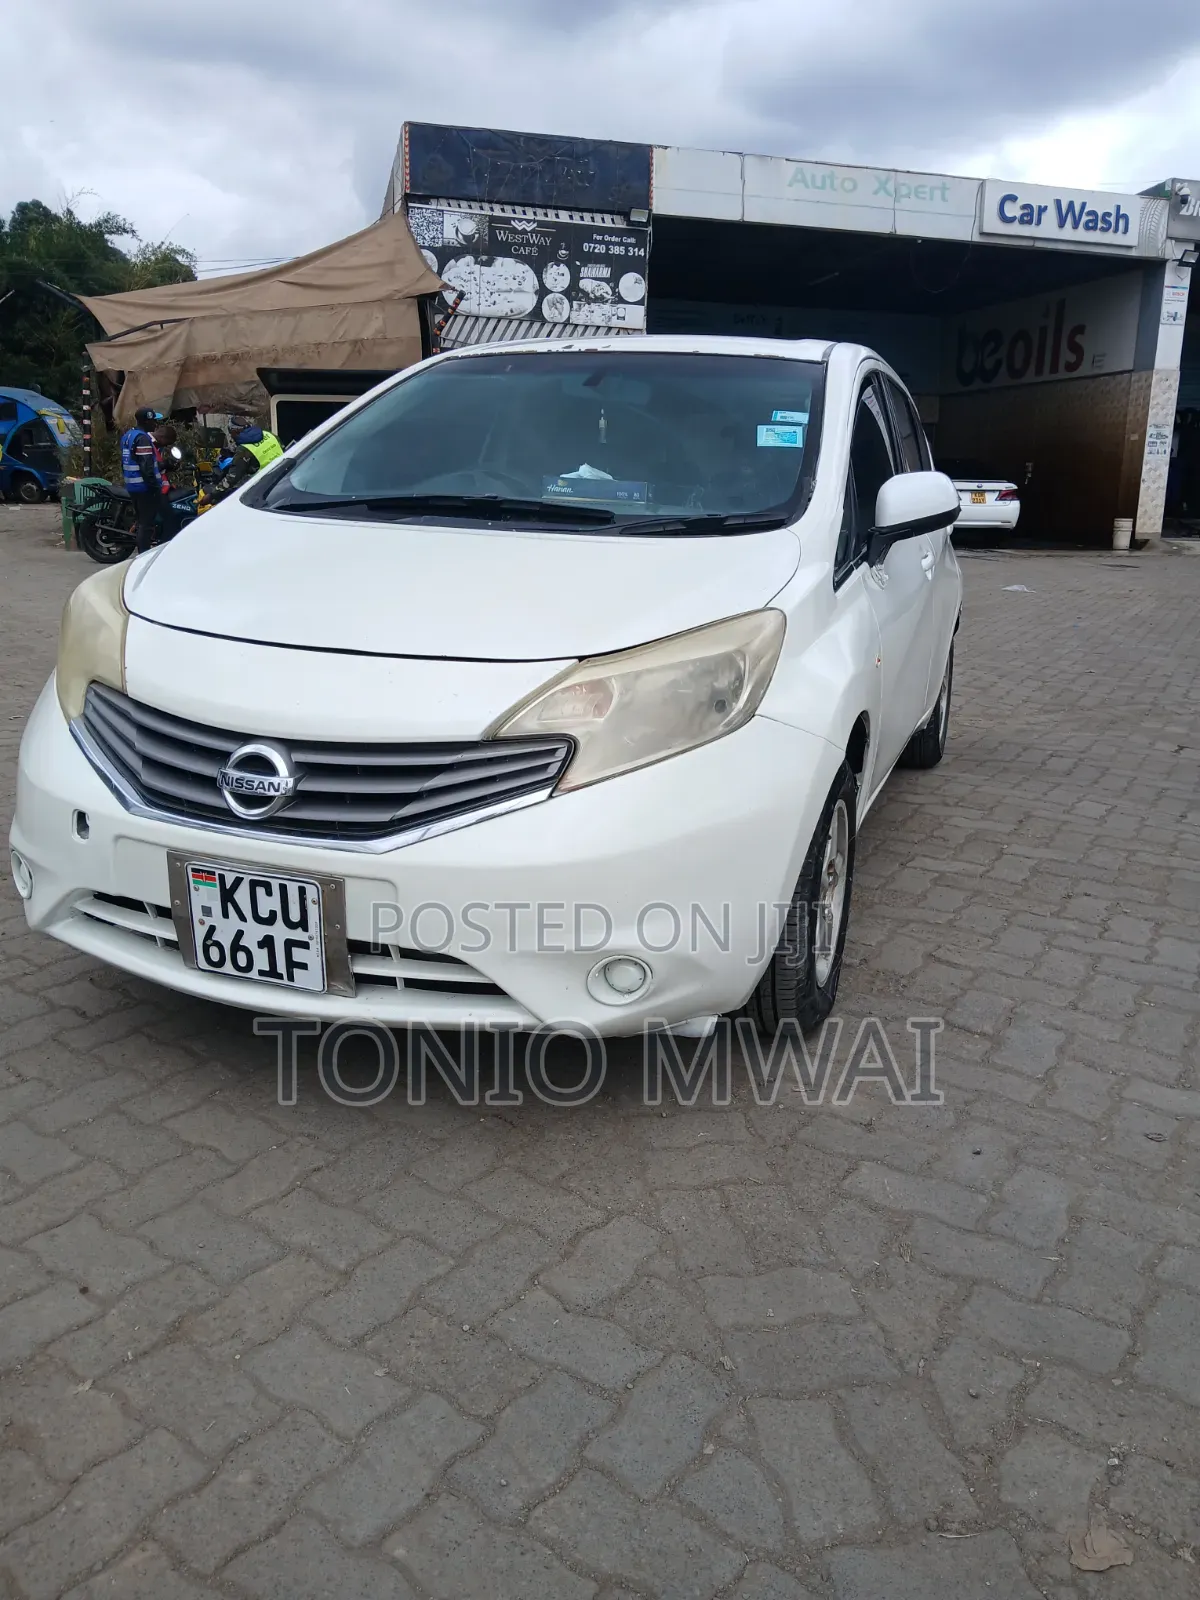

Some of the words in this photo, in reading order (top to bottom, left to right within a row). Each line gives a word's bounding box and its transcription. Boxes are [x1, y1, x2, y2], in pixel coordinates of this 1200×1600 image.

[787, 166, 858, 193] Auto
[872, 172, 950, 203] Xpert
[998, 193, 1048, 227] Car
[1056, 199, 1130, 235] Wash
[511, 245, 539, 256] CAFÉ
[583, 243, 606, 253] 0720
[608, 245, 626, 255] 385
[628, 247, 645, 257] 314
[604, 235, 622, 243] Order
[622, 236, 637, 244] Call:
[219, 774, 281, 794] NISSAN
[218, 873, 309, 933] KCU
[202, 924, 311, 982] 661F
